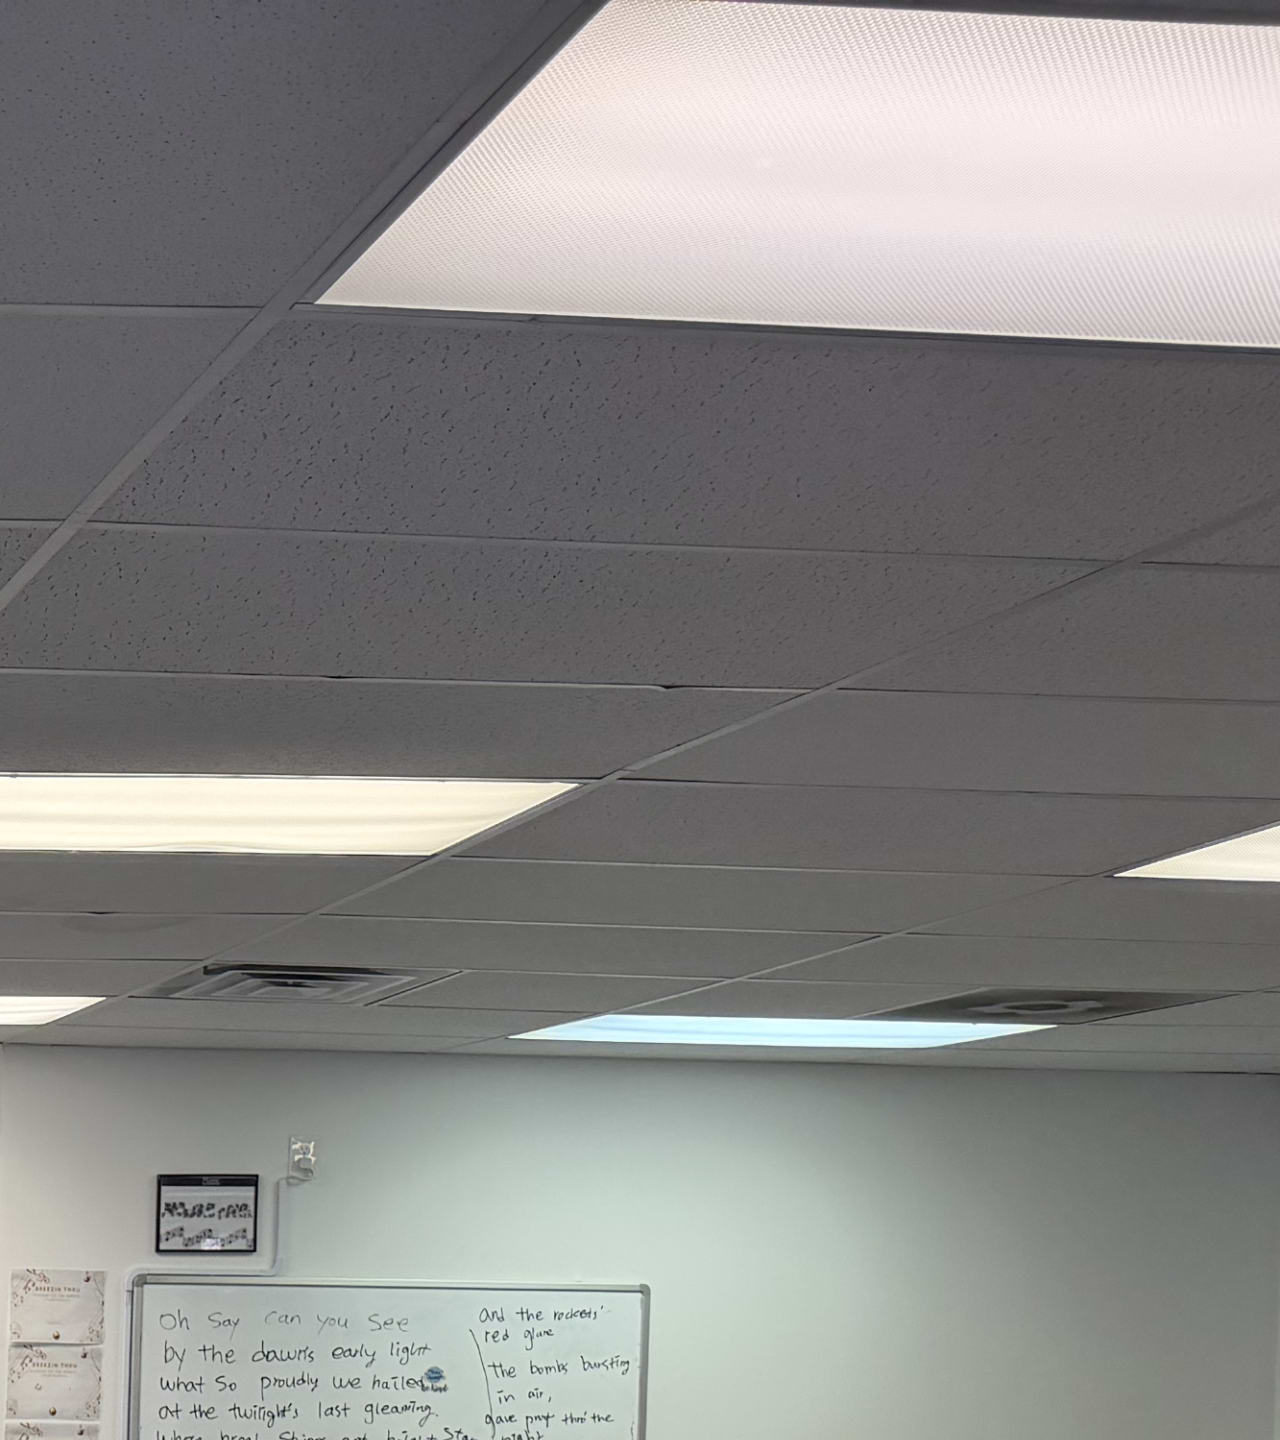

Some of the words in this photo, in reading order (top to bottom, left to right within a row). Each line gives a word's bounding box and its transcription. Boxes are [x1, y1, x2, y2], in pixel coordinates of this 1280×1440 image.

[516, 1307, 544, 1322] the
[317, 1315, 348, 1335] you
[485, 1328, 510, 1343] red
[164, 1340, 186, 1372] by
[198, 1344, 237, 1364] the
[332, 1343, 376, 1368] early
[488, 1362, 517, 1378] the
[260, 1372, 318, 1400] proudly
[333, 1376, 362, 1390] we
[496, 1390, 515, 1404] in
[159, 1402, 182, 1420] at
[189, 1402, 218, 1420] the
[318, 1402, 350, 1418] last
